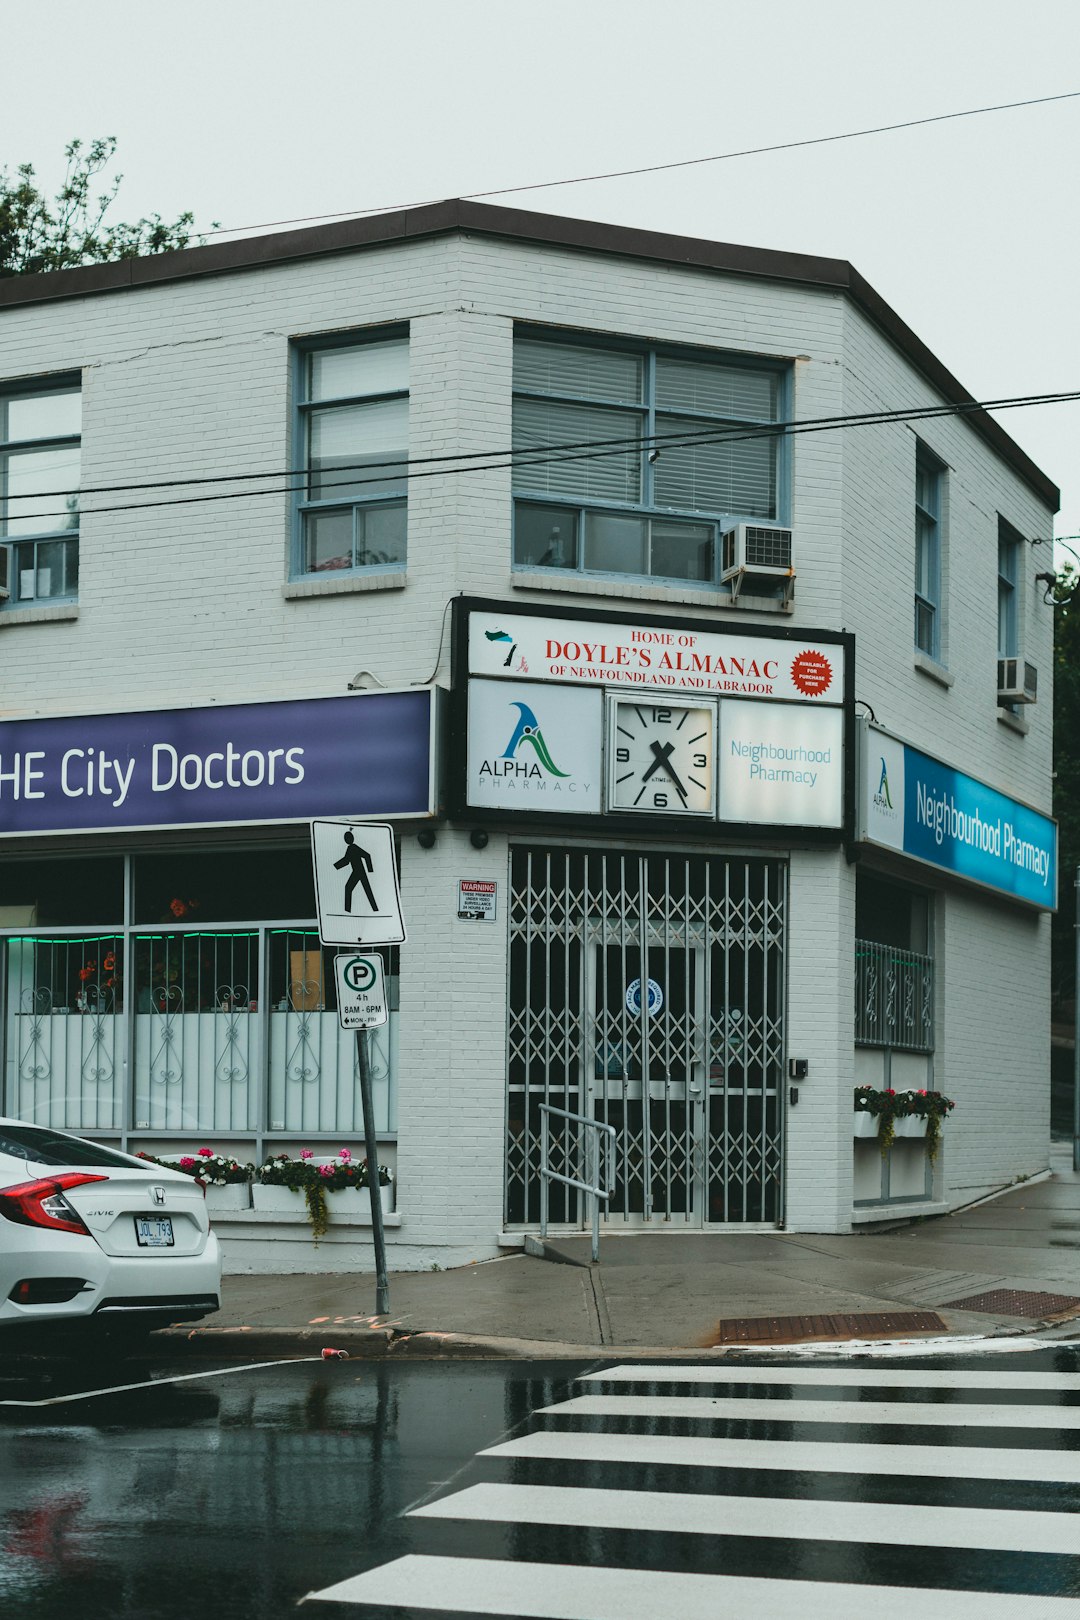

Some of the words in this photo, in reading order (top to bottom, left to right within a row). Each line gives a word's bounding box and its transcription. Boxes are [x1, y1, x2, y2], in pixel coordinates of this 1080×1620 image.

[631, 631, 675, 646] HOME
[678, 635, 698, 648] OF
[545, 639, 652, 668] DOYLE'S
[658, 651, 779, 679] ALMANAC
[549, 664, 567, 676] OF
[570, 666, 676, 686] NEWFOUNDLAND
[678, 677, 704, 689] AND
[707, 679, 774, 695] LABRADOR
[798, 673, 826, 681] PURCHASE
[652, 708, 672, 724] 12
[616, 747, 630, 763] 9
[731, 740, 831, 764] Neighbourhood
[693, 753, 707, 768] 3
[61, 748, 136, 807] City
[151, 742, 305, 792] Doctors
[478, 760, 543, 779] ALPHA
[750, 763, 818, 788] Pharmacy
[478, 777, 592, 793] PHARMACY
[653, 792, 668, 808] 6
[873, 794, 887, 808] ALPHA
[916, 780, 1000, 857] Neighbourhood
[1003, 822, 1050, 887] Pharmacy
[462, 883, 494, 891] WARNING
[353, 966, 368, 984] P
[366, 1005, 381, 1013] 6PM
[156, 1223, 172, 1236] 793
